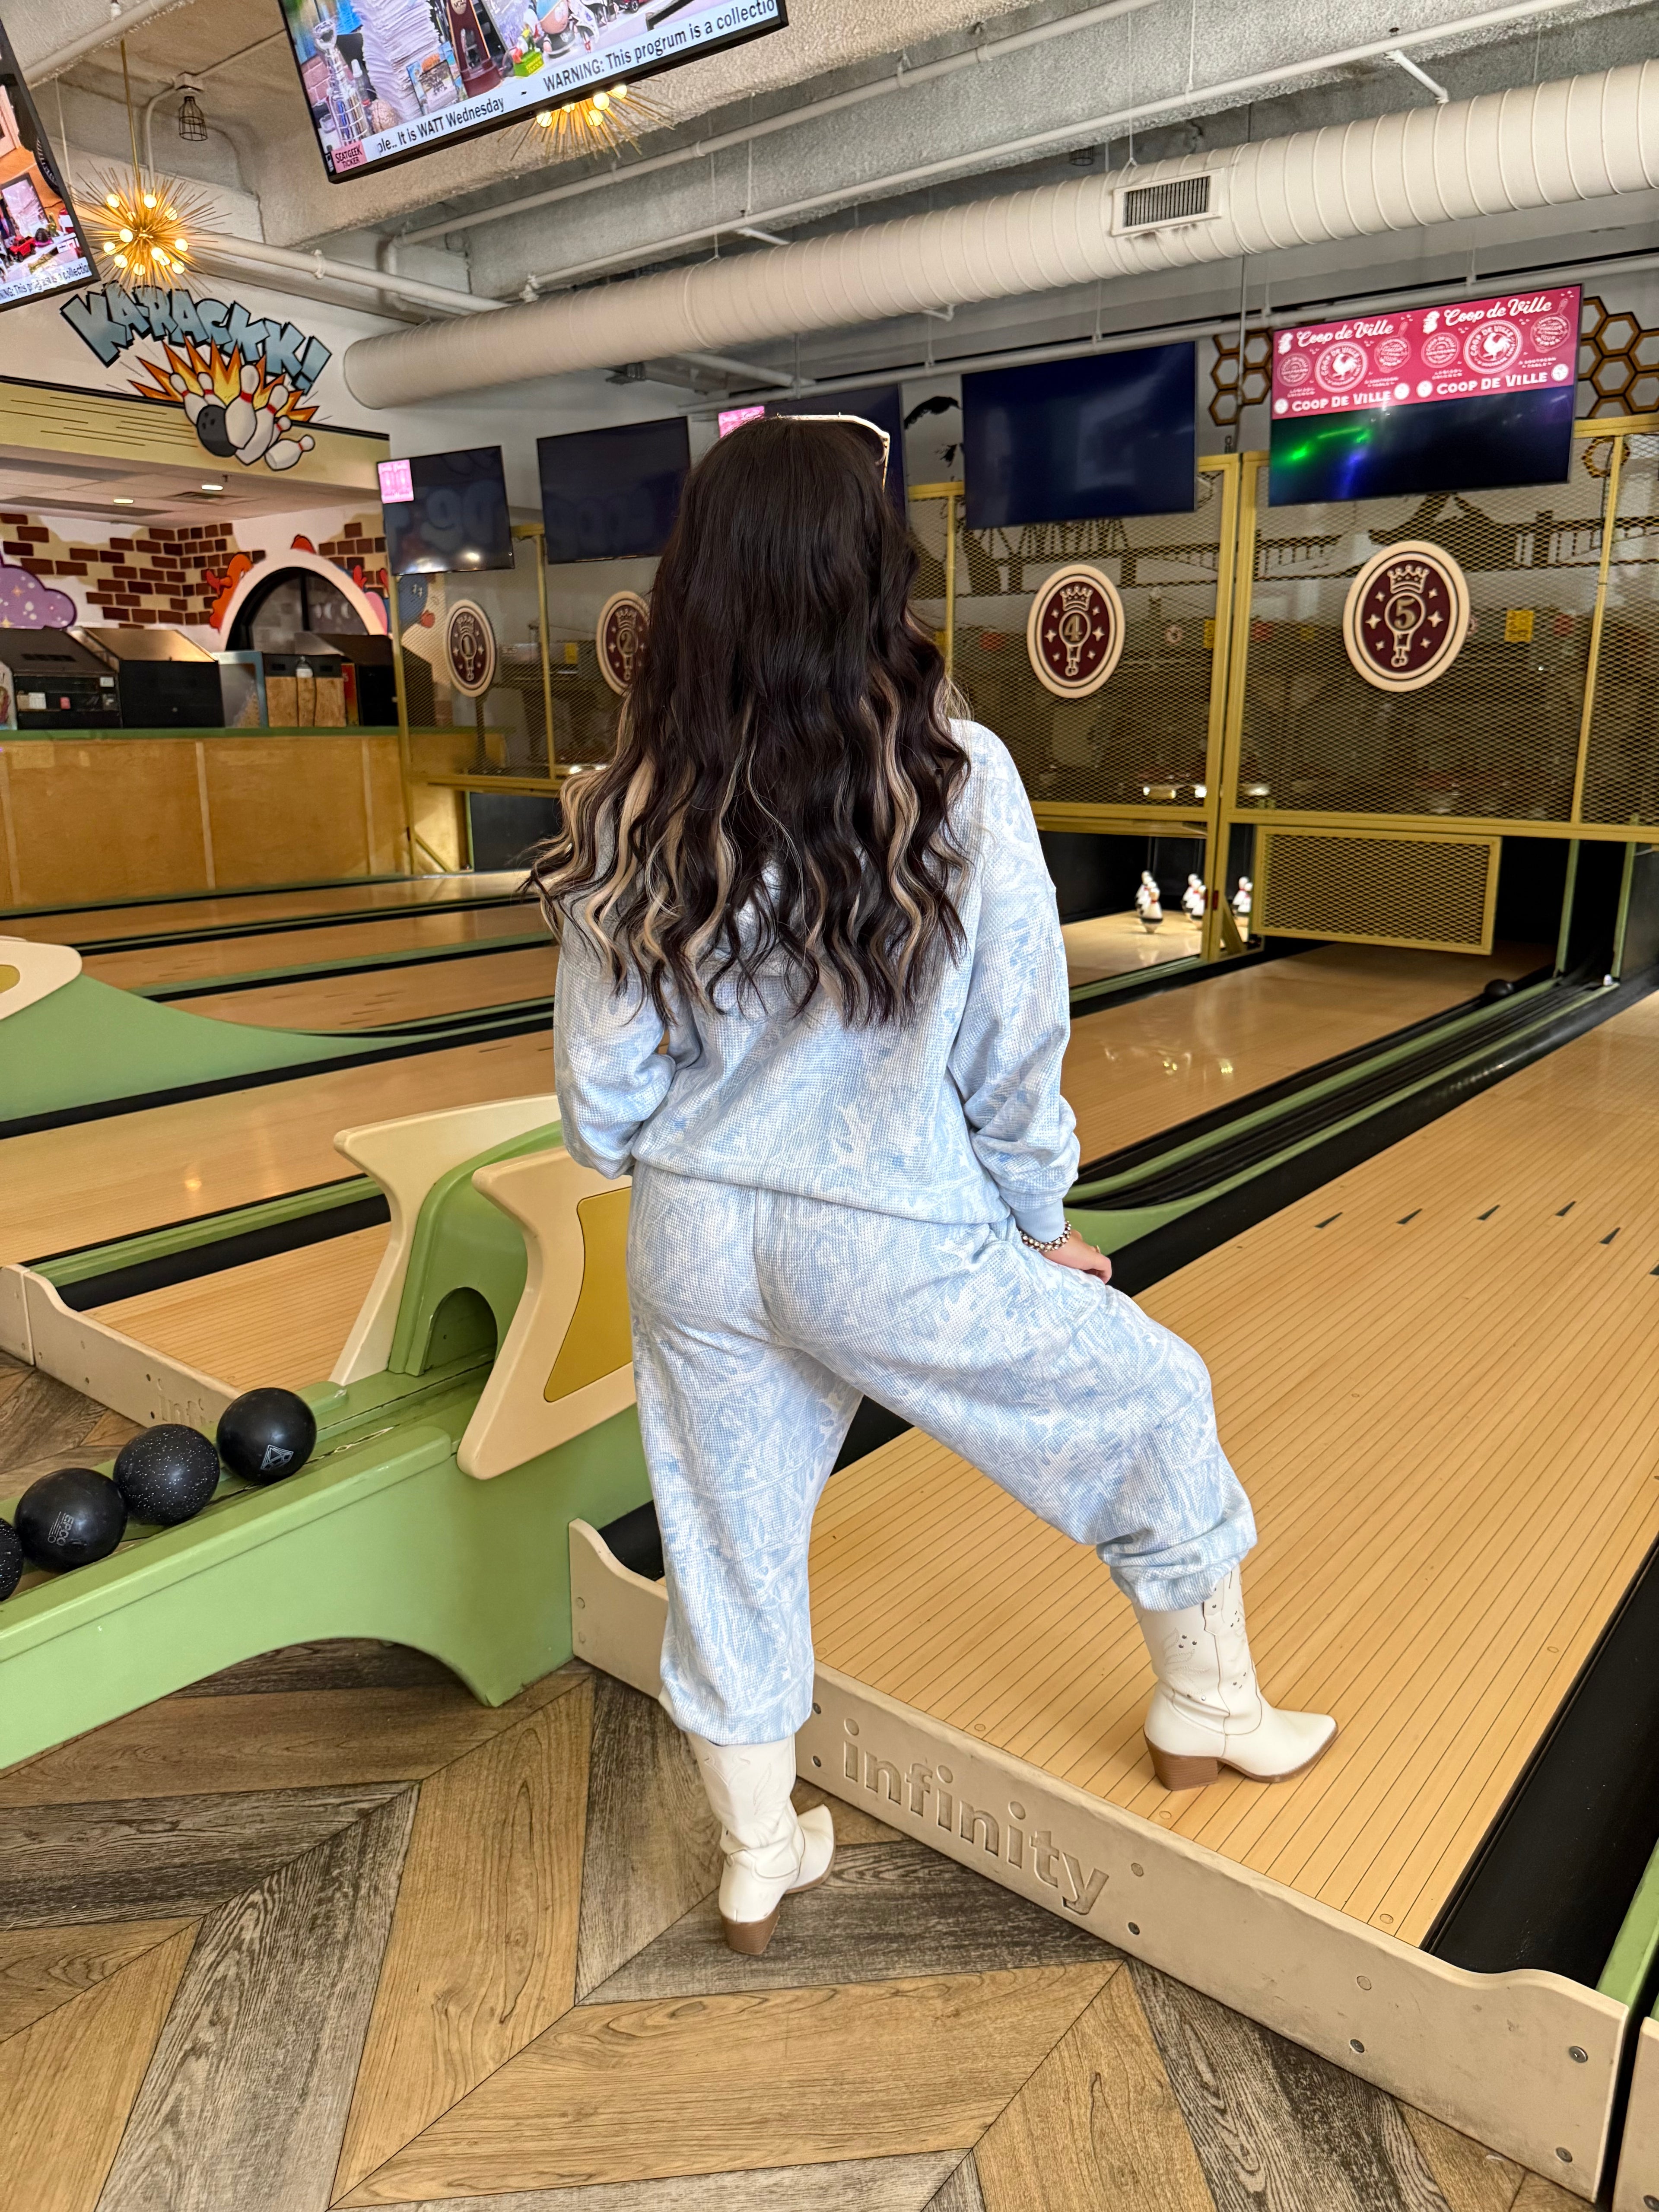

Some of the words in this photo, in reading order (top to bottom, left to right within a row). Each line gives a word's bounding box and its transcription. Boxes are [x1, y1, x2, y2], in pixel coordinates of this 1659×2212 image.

[397, 131, 407, 146] It
[407, 128, 417, 142] is
[416, 116, 445, 138] WATT
[445, 98, 505, 128] Wednesday
[543, 58, 605, 92] WARNING:
[605, 49, 632, 69] This
[634, 30, 687, 64] progrum
[689, 23, 701, 40] is
[704, 22, 713, 34] a
[716, 0, 775, 29] collectio
[335, 145, 363, 163] SEATGEEK
[341, 156, 360, 168] TICKER
[1444, 308, 1485, 327] Coop
[1486, 301, 1506, 318] de
[1507, 296, 1552, 316] Ville
[1297, 331, 1334, 347] Coop
[1335, 324, 1353, 340] de
[1354, 319, 1394, 339] Ville
[1437, 380, 1478, 395] COOP
[1481, 378, 1501, 390] DE
[1505, 372, 1548, 387] VILLE
[1291, 398, 1329, 412] COOP
[1331, 395, 1350, 408] DE
[1353, 391, 1392, 406] VILLE
[1394, 598, 1416, 629] 5
[1065, 614, 1083, 642] 4
[462, 636, 472, 655] 1
[621, 631, 634, 653] 2
[844, 1717, 1109, 1915] infinity
